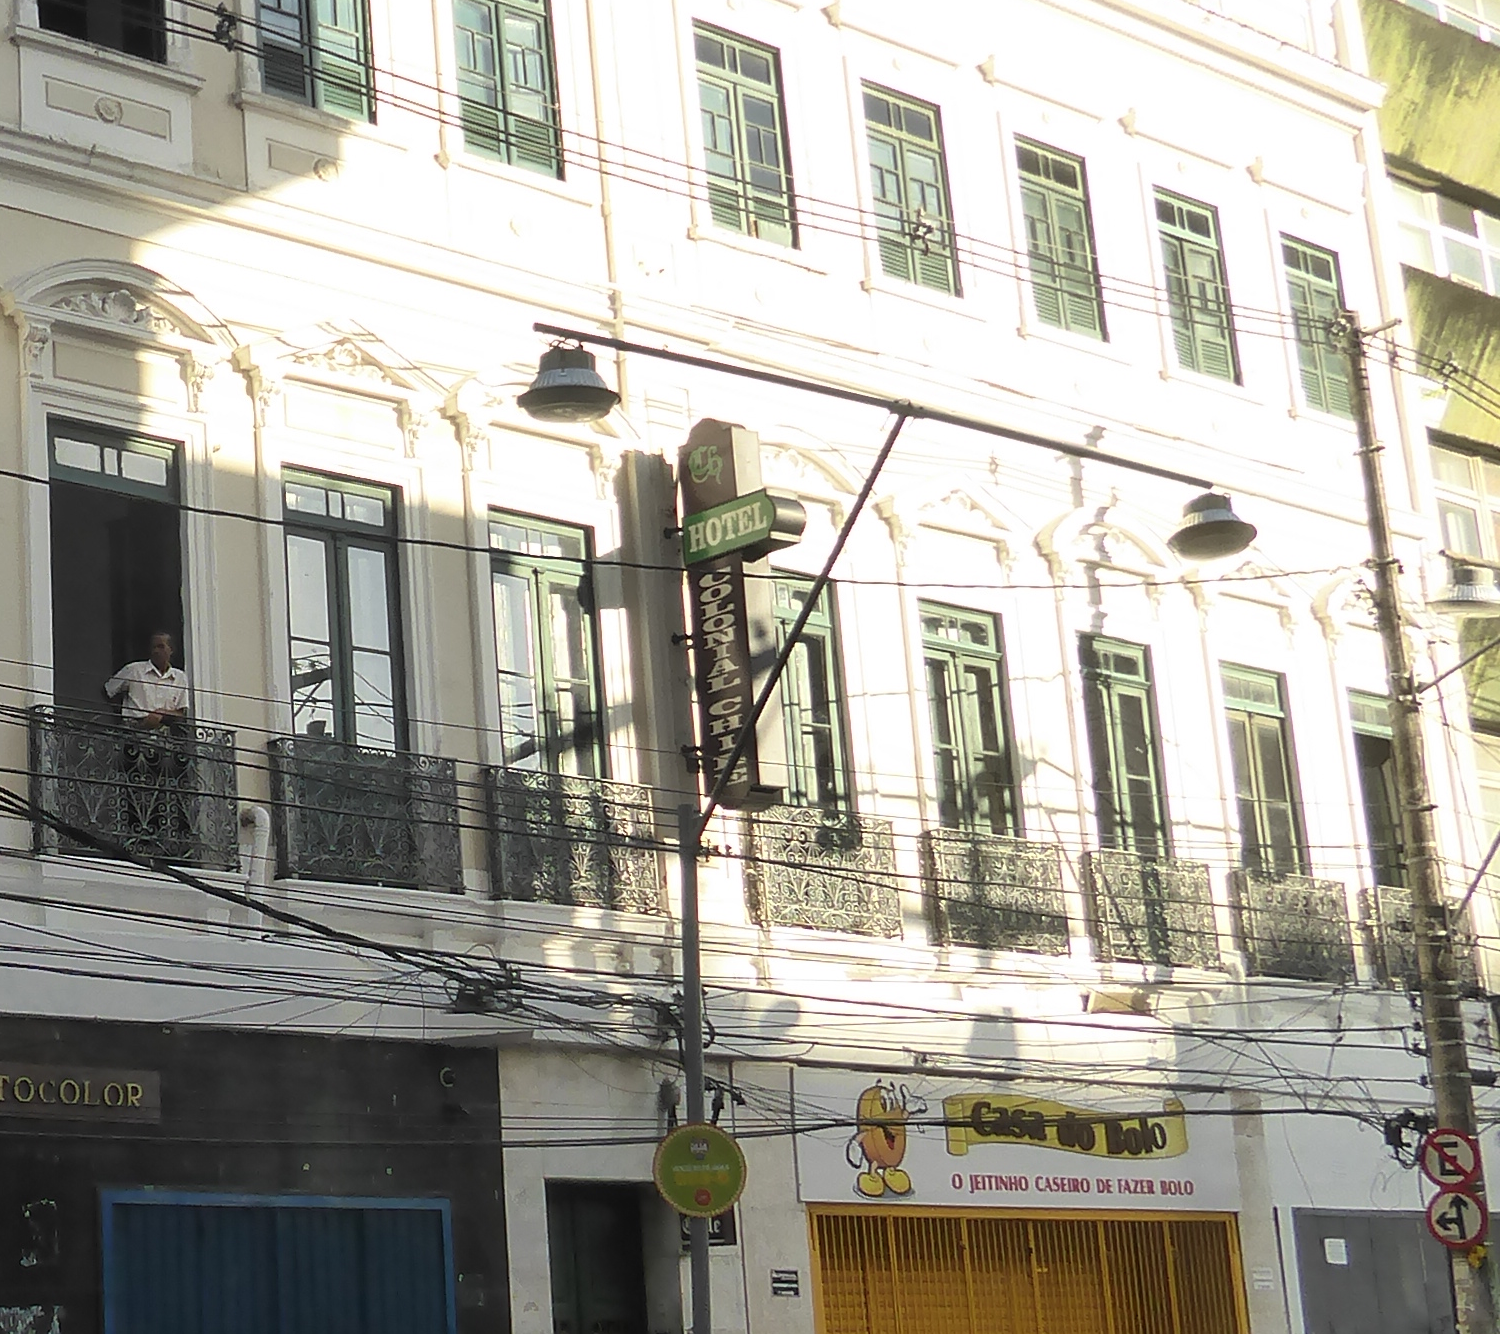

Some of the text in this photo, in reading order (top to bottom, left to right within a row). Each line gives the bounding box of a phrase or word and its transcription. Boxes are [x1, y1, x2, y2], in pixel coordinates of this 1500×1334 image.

[688, 501, 768, 553] HOTEL
[698, 566, 742, 695] COLONIAL
[970, 1100, 1168, 1156] Casa do Bolo
[951, 1173, 1195, 1196] O JEITINHO CASEIRO DE FAZER BOLO
[1437, 1140, 1462, 1177] E
